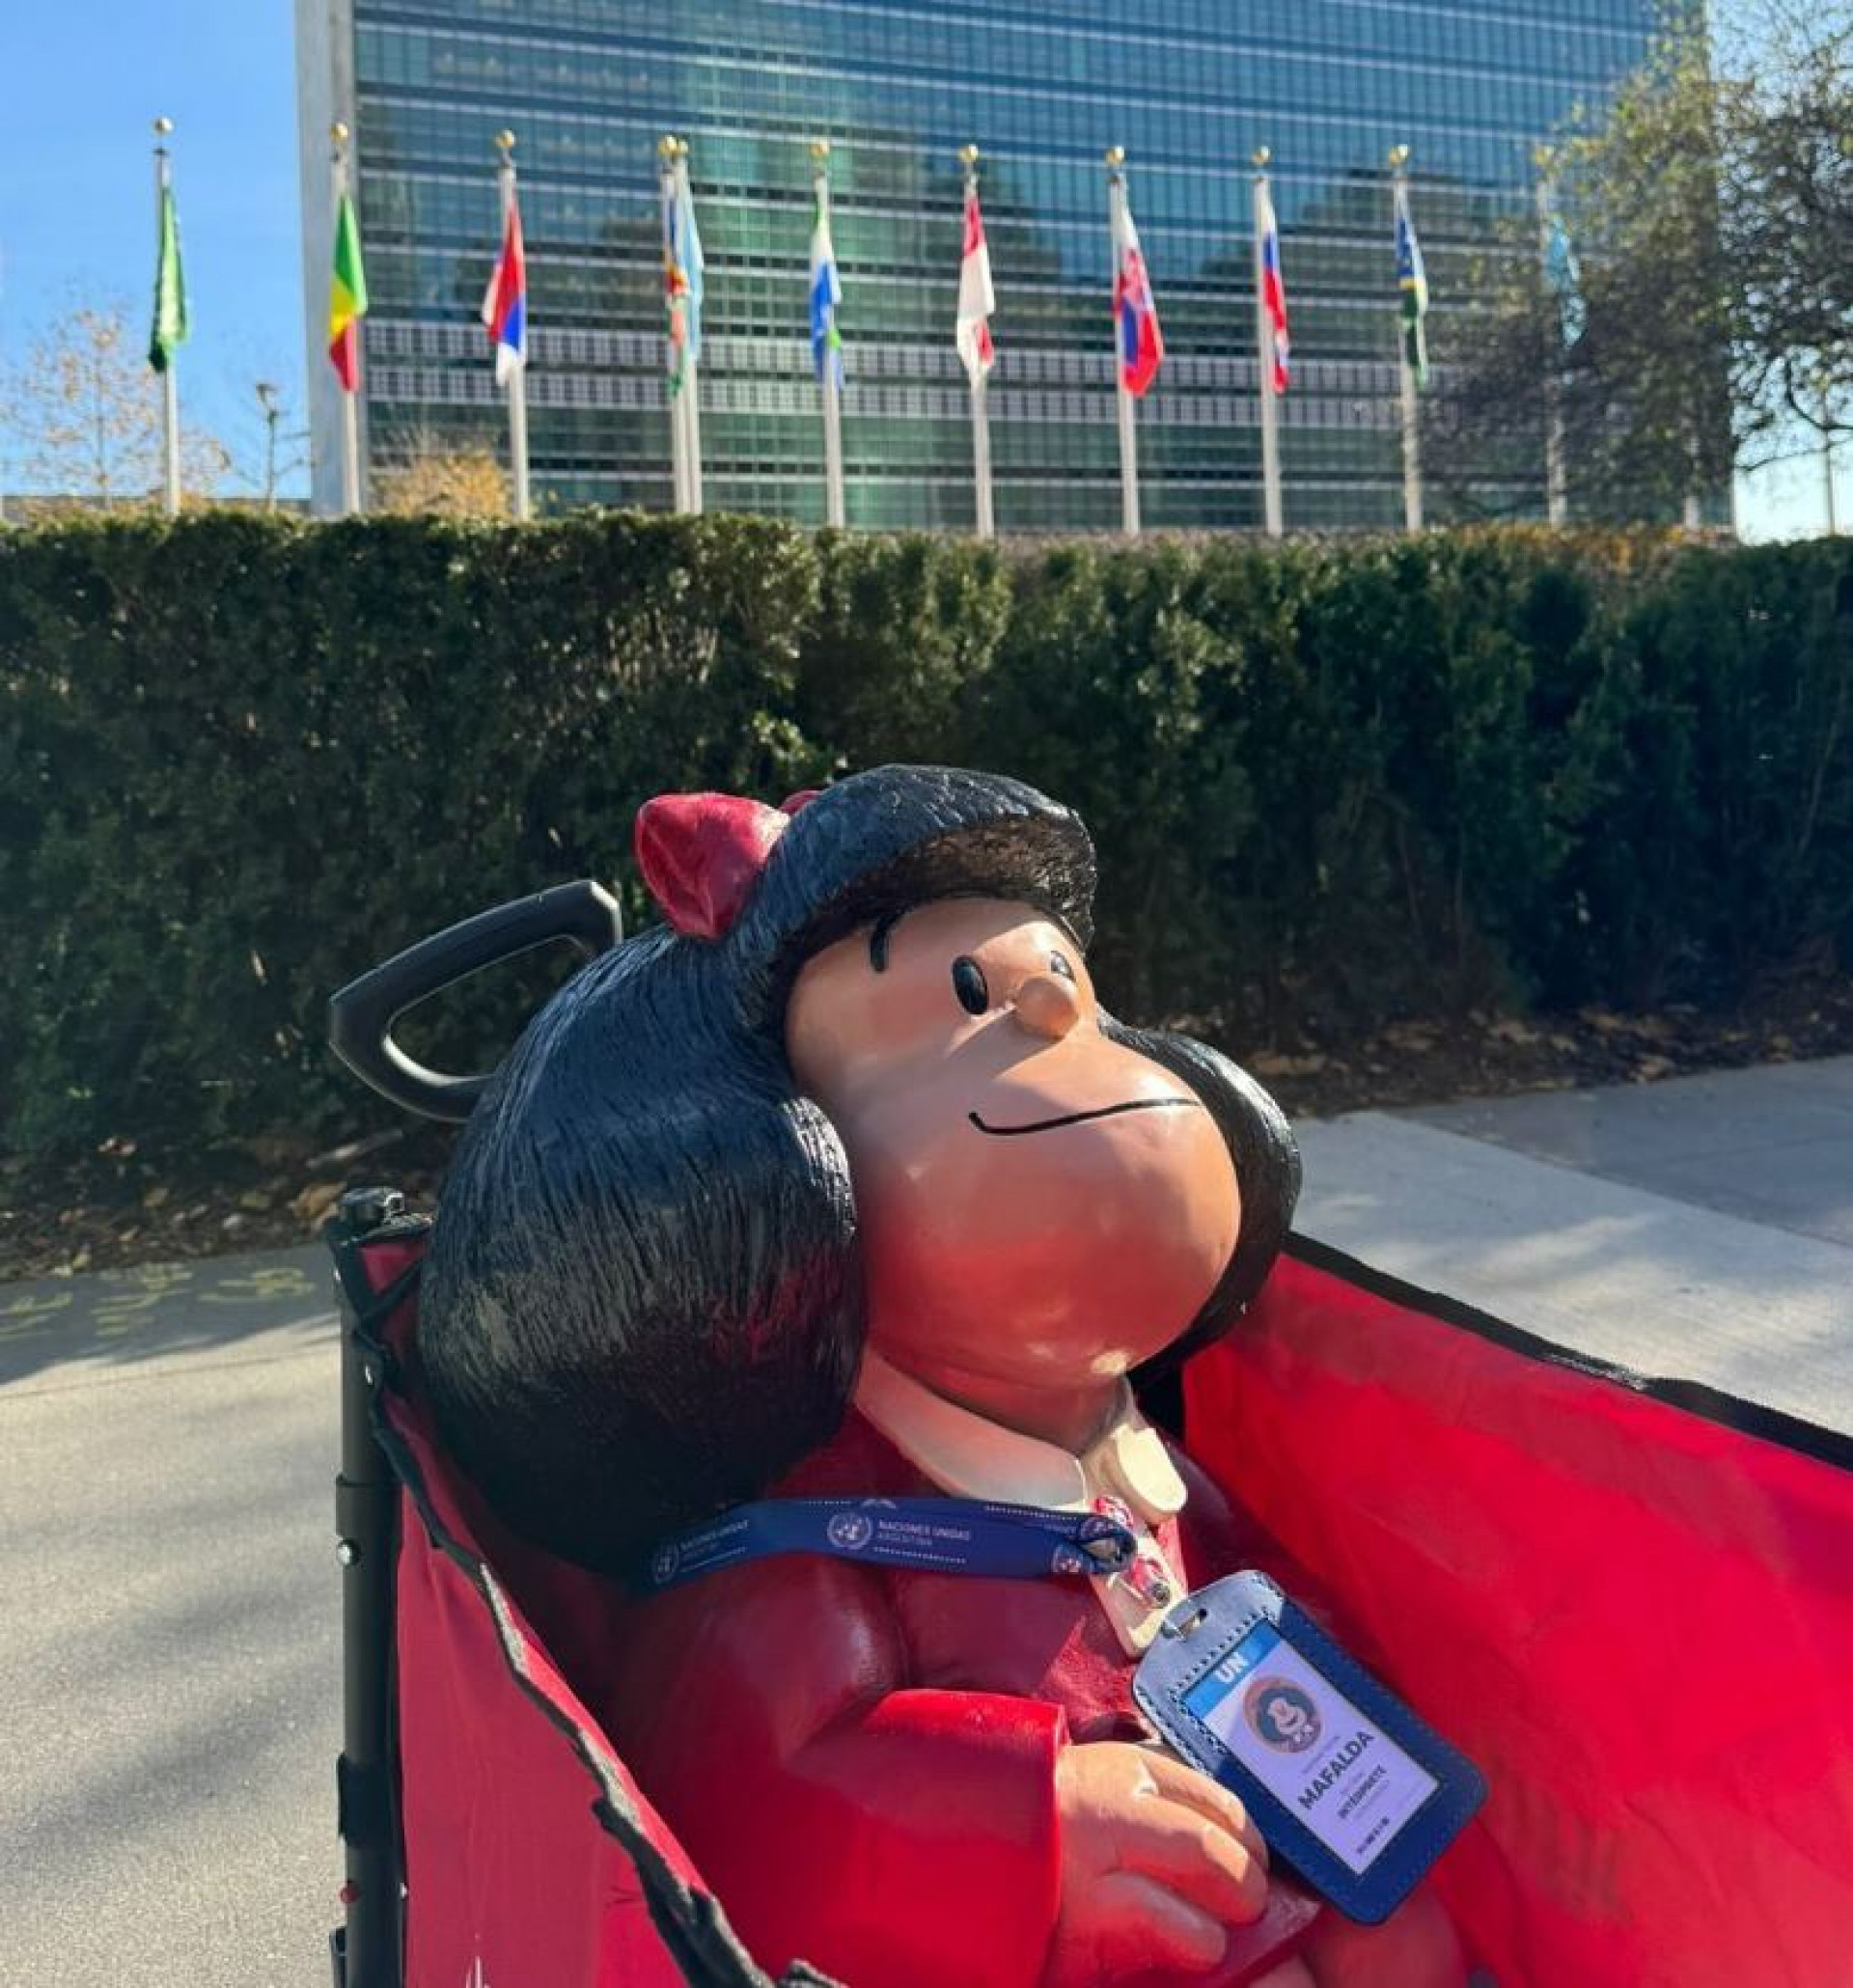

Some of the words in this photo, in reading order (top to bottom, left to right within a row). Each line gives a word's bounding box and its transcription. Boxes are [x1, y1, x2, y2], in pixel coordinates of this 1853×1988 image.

[932, 1527, 971, 1541] UNIDAS
[1215, 1651, 1249, 1683] UN
[1297, 1731, 1375, 1810] MAFALDA
